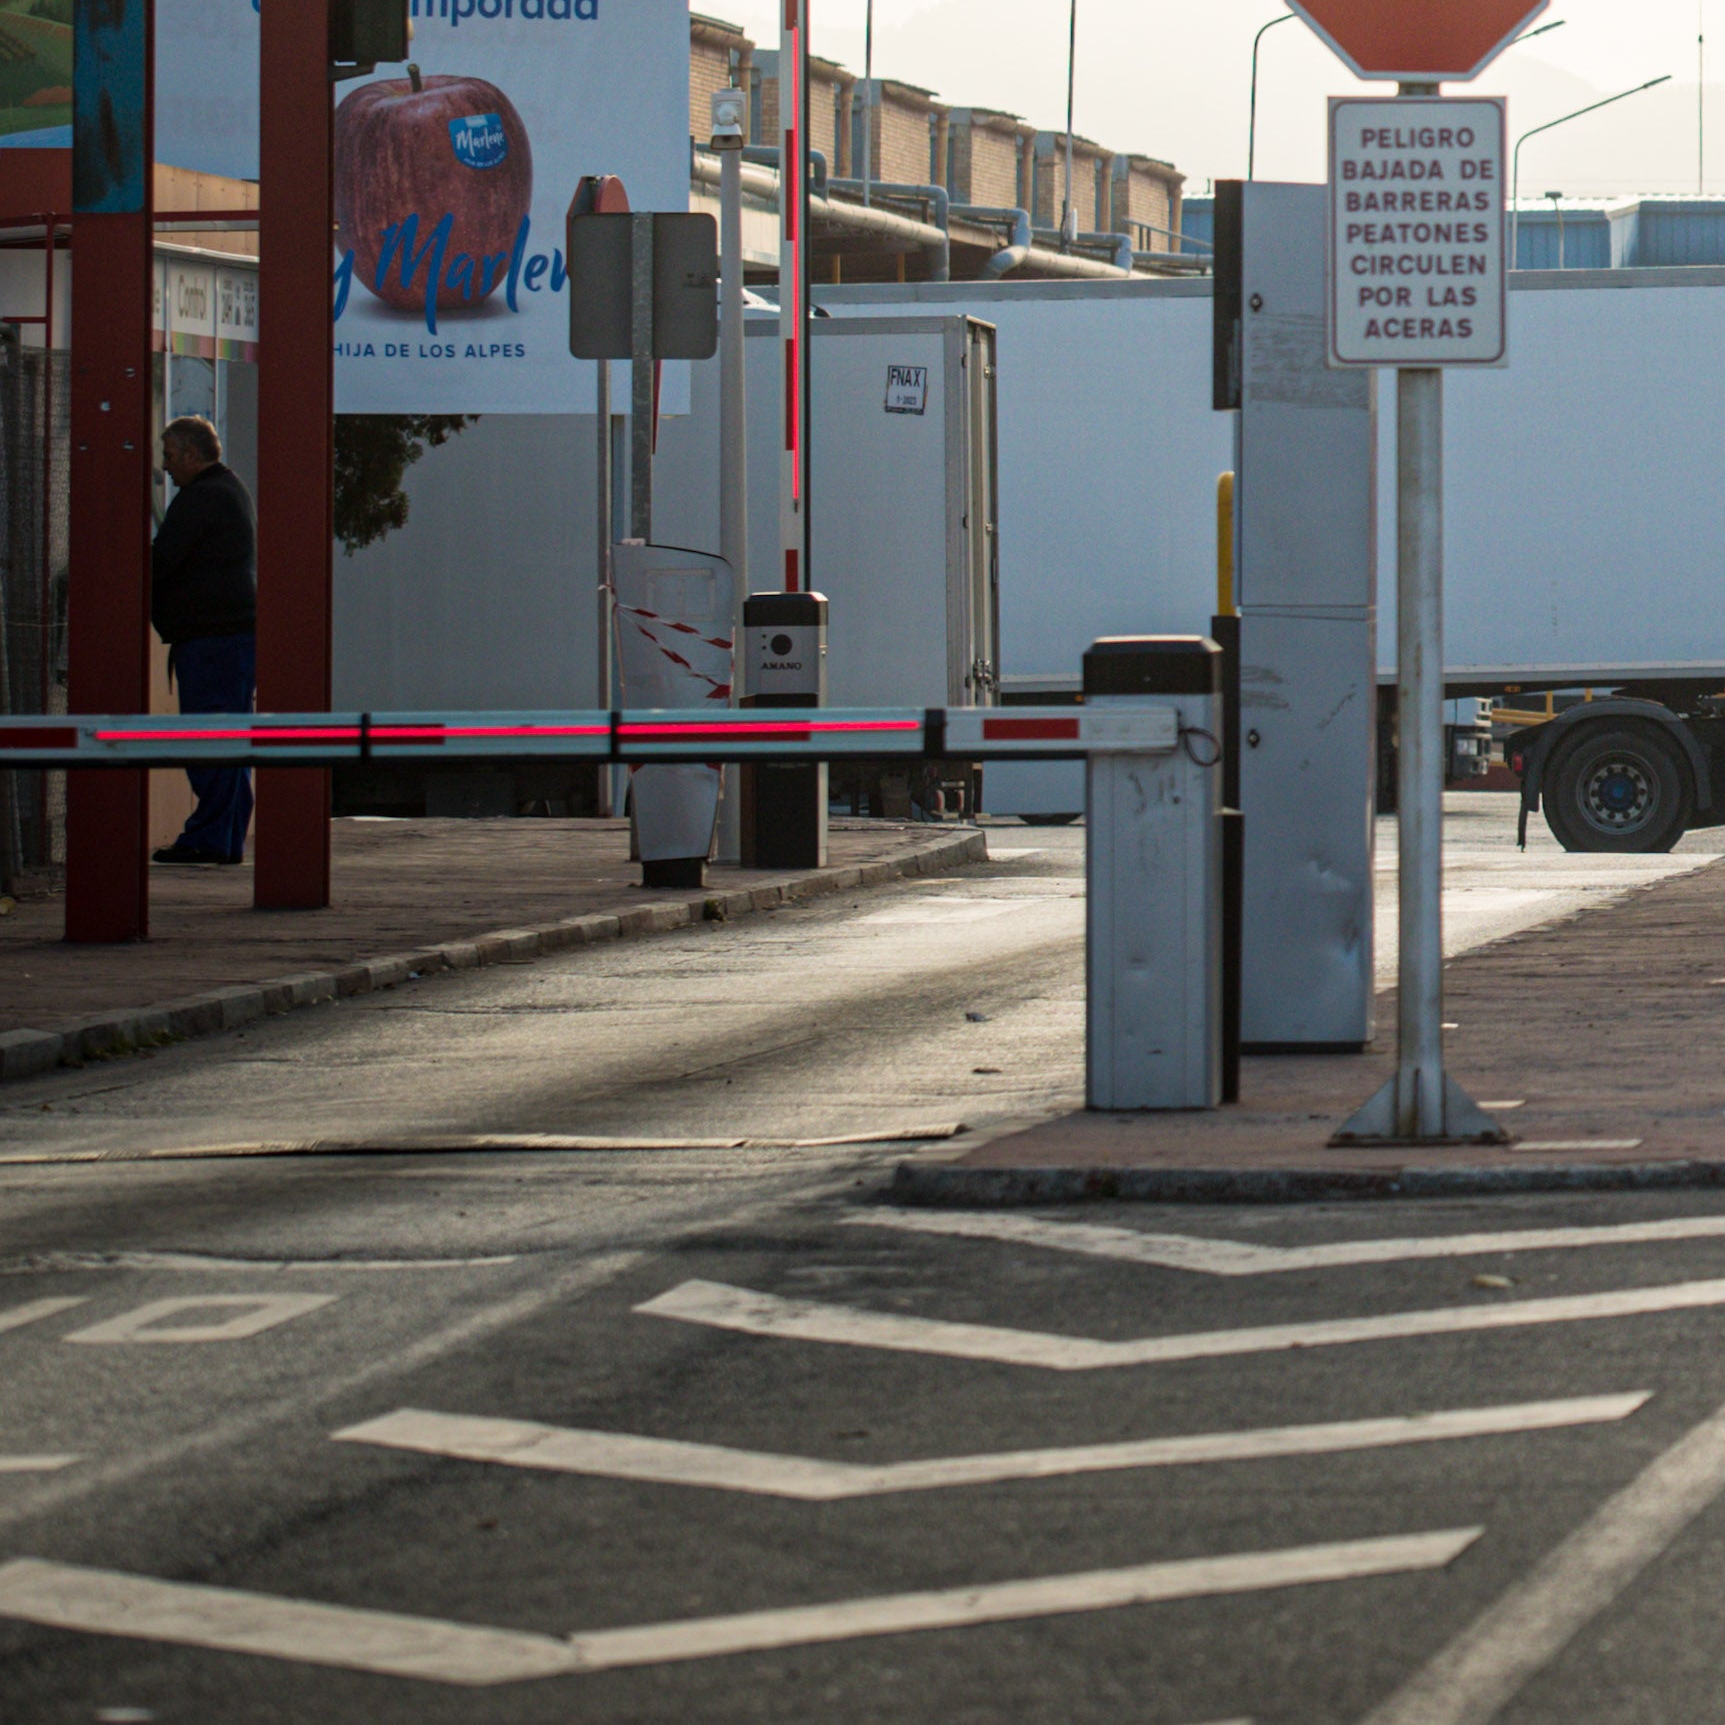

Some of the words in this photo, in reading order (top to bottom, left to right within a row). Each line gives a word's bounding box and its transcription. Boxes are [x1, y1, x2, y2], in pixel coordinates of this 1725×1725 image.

[1361, 127, 1475, 149] PELIGRO
[1342, 159, 1445, 181] BAJADA
[1459, 159, 1494, 180] DE
[1345, 191, 1490, 212] BARRERAS
[1346, 223, 1489, 244] PEATONES
[374, 212, 569, 336] Marlen
[1350, 254, 1487, 275] CIRCULEN
[1358, 286, 1412, 308] POR
[1427, 286, 1477, 308] LAS
[1363, 318, 1474, 339] ACERAS
[384, 343, 410, 358] DE
[419, 343, 456, 359] LOS
[464, 343, 526, 359] ALPES
[890, 367, 921, 387] FNAX
[761, 661, 803, 671] AMANO
